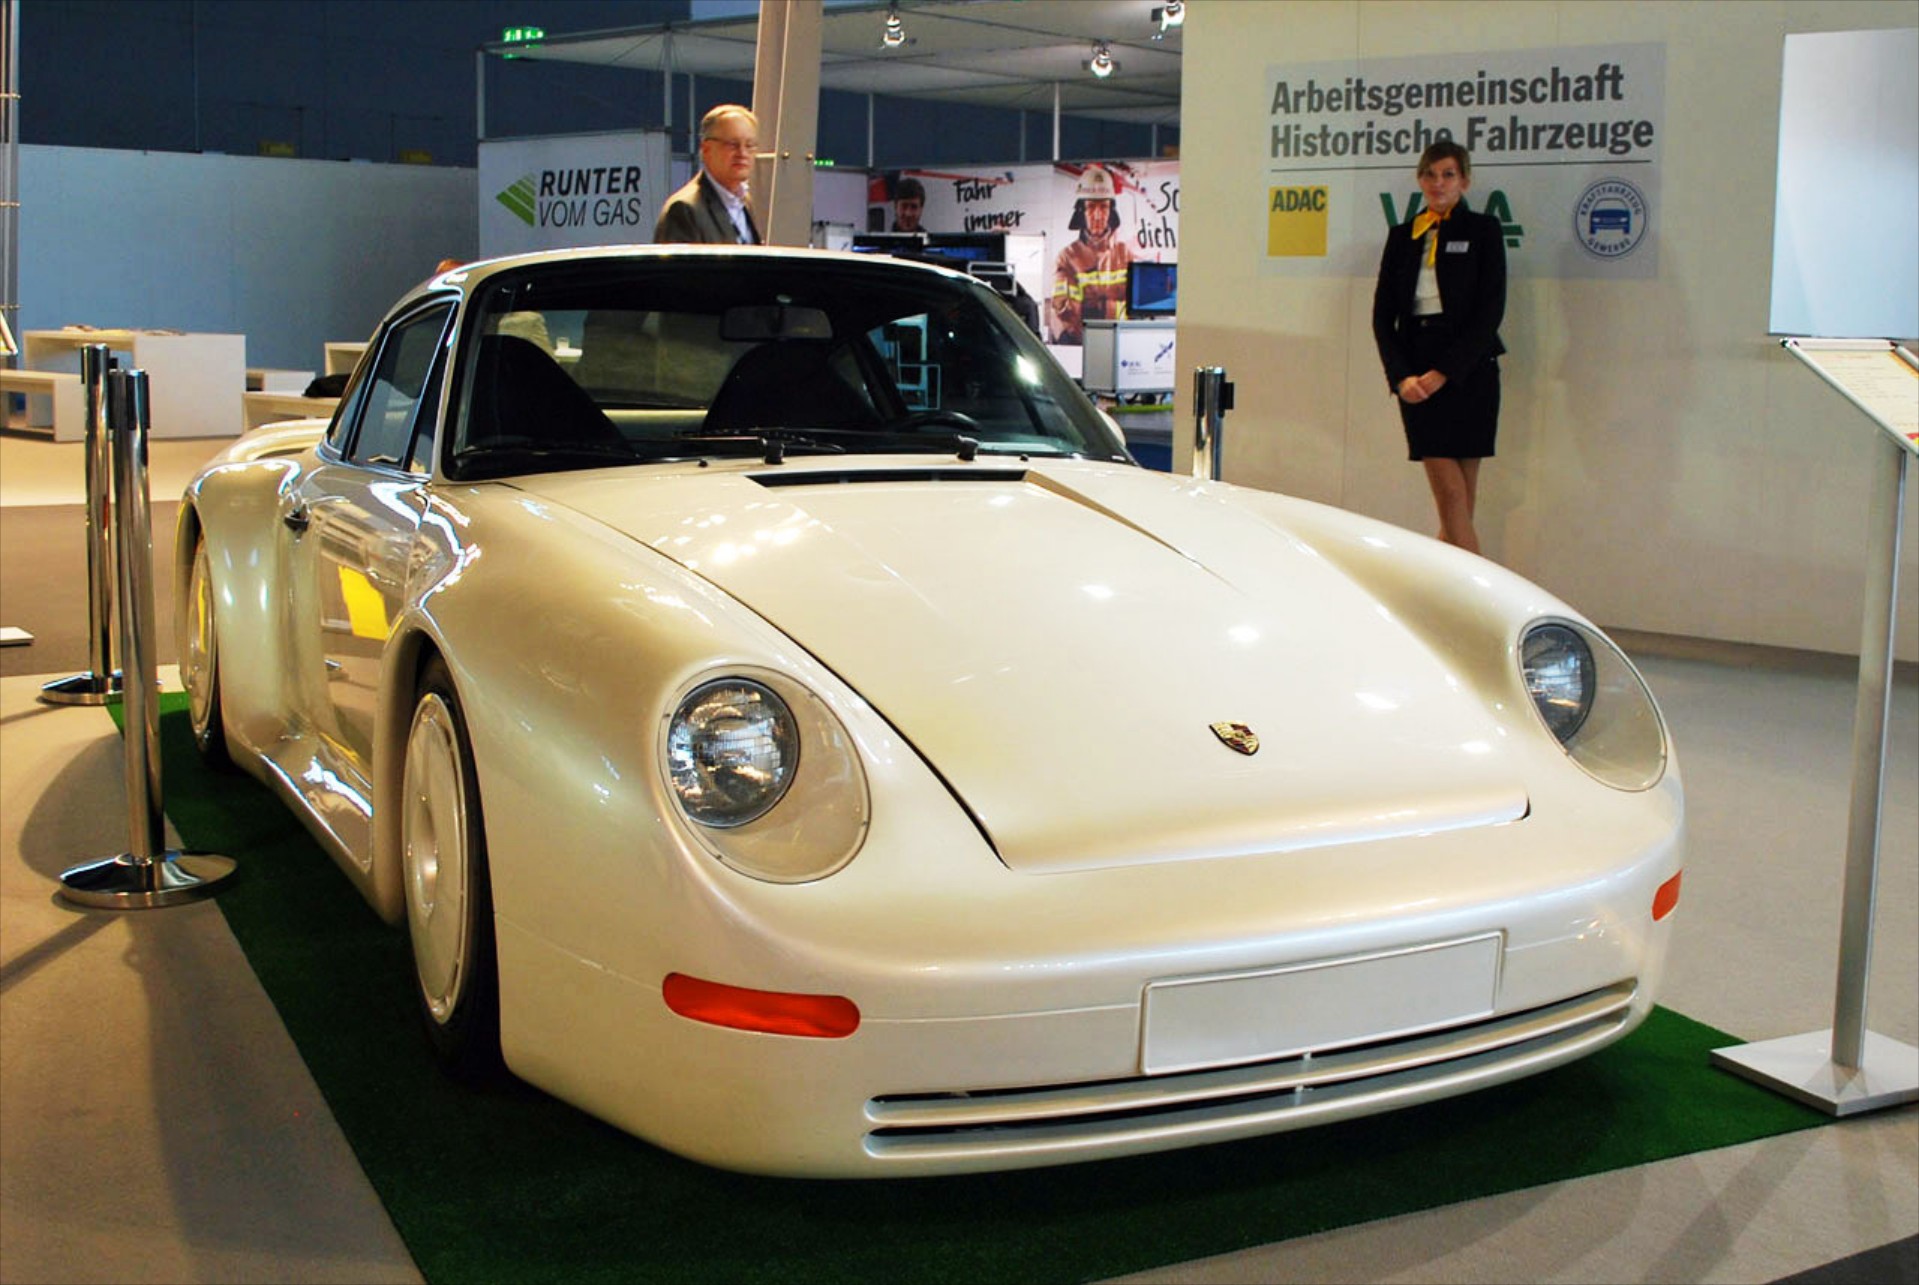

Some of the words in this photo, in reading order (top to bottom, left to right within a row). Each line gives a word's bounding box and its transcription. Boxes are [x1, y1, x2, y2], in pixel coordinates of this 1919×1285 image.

[1271, 63, 1624, 116] Arbeitsgemeinschaft
[1271, 118, 1454, 158] Historische
[1467, 115, 1655, 155] Fahrzeuge
[540, 165, 642, 197] RUNTER
[952, 177, 997, 204] Fahr
[539, 200, 588, 227] VOM
[593, 197, 642, 226] GAS
[1271, 188, 1327, 212] ADAC
[964, 207, 1027, 233] immer
[1137, 215, 1177, 248] dich
[1379, 189, 1525, 249] VA
